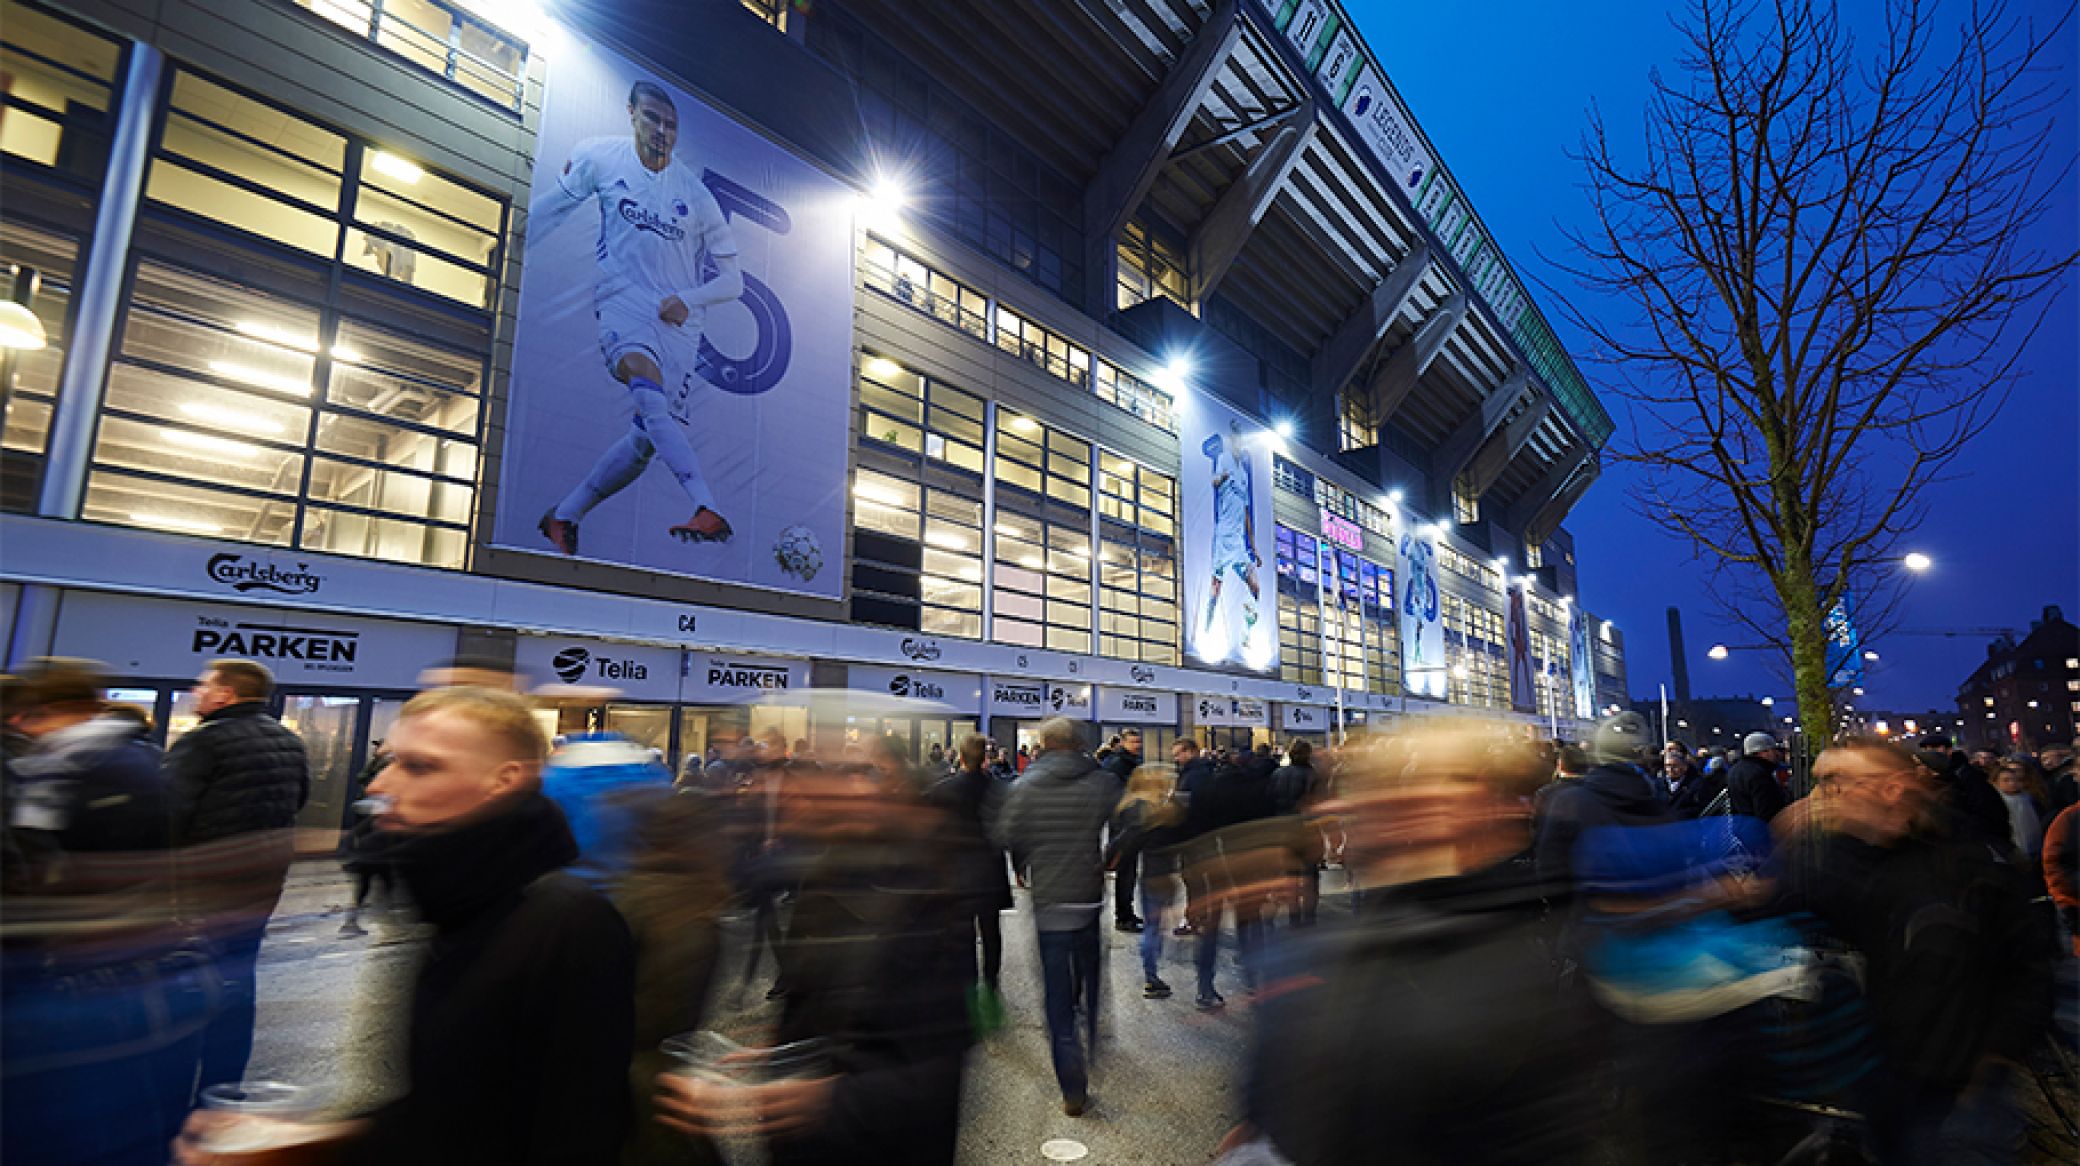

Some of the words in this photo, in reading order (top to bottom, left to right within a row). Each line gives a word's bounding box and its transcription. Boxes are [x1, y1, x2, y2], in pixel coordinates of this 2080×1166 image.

[619, 197, 686, 241] Carlsberg
[207, 553, 321, 594] Carlsberg
[678, 614, 696, 632] C4
[192, 630, 357, 662] PARKEN
[595, 657, 648, 680] Telia
[708, 668, 788, 689] PARKEN
[913, 680, 943, 699] Telia
